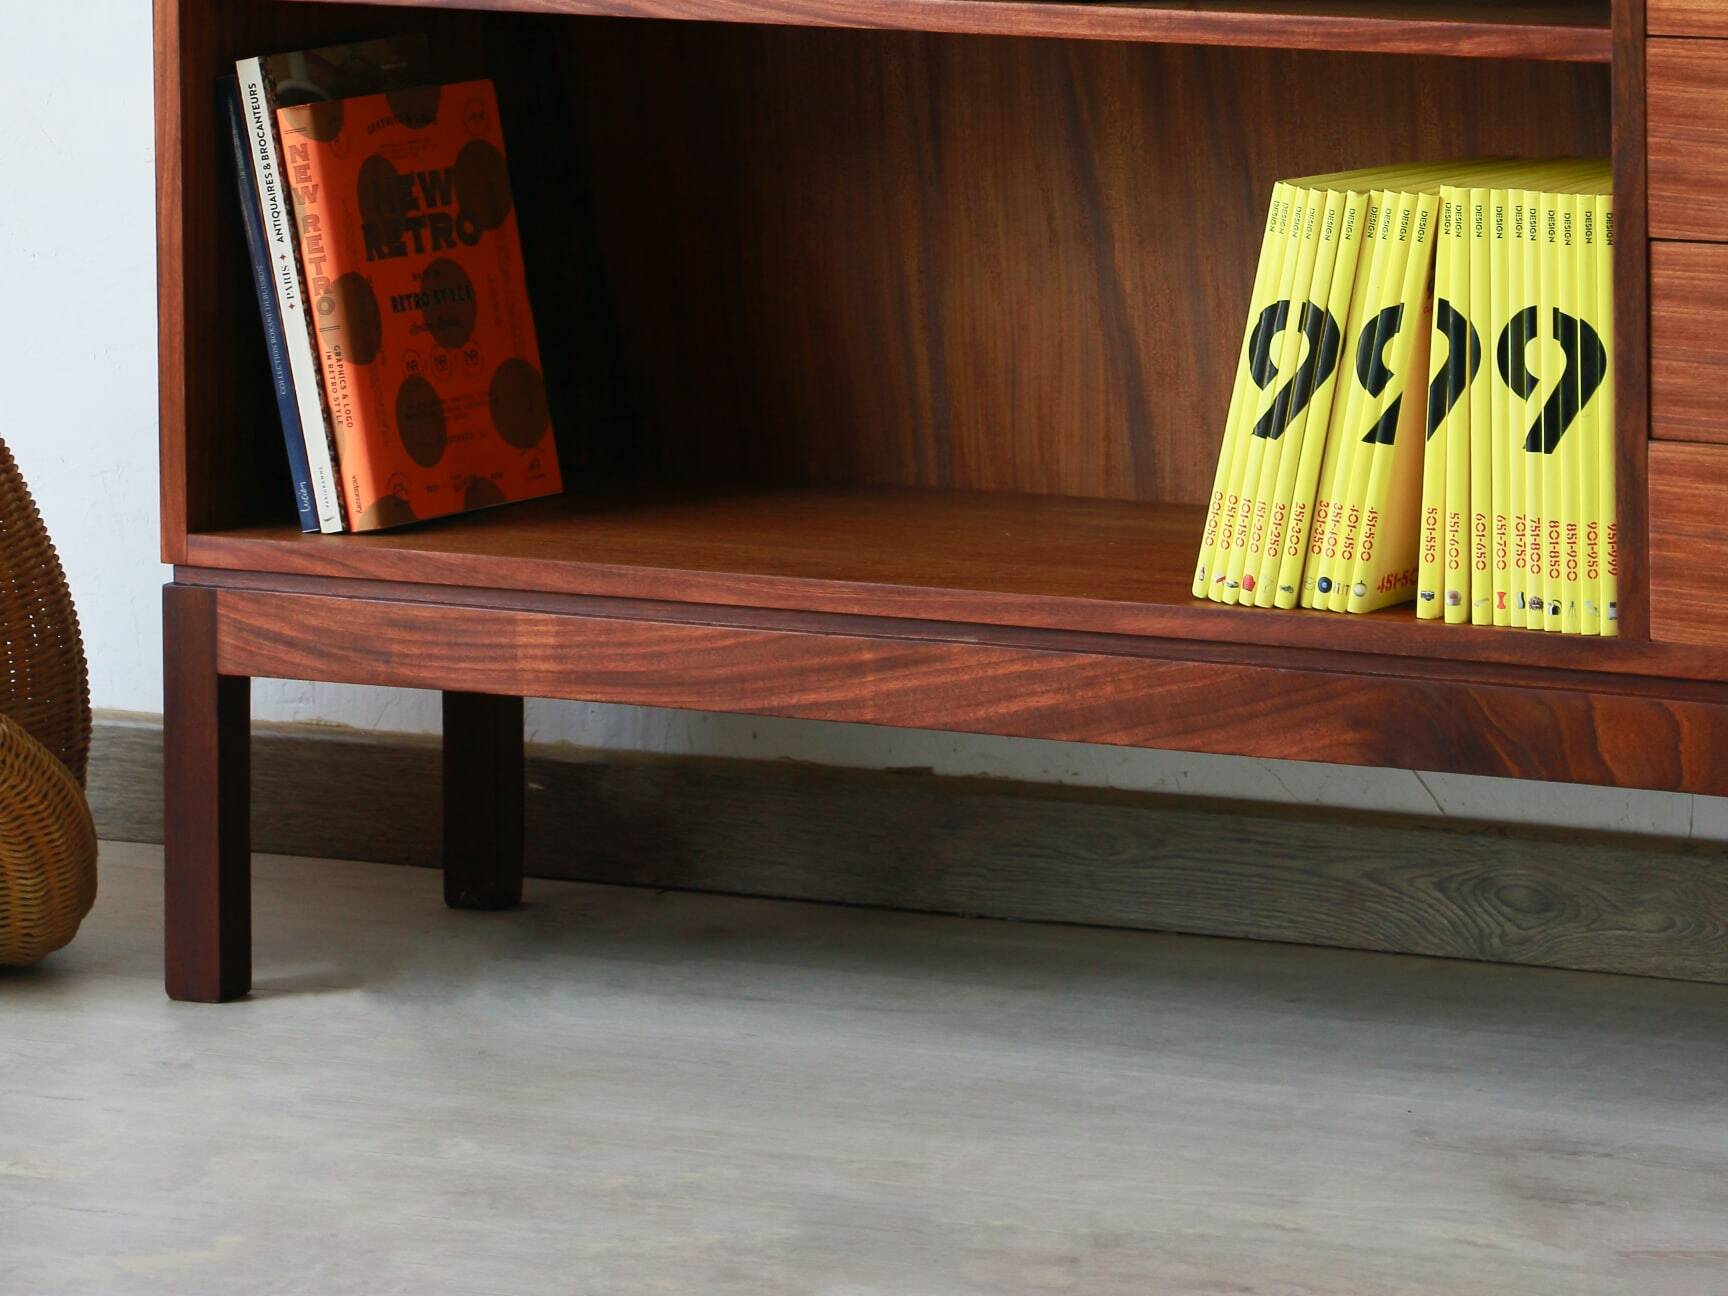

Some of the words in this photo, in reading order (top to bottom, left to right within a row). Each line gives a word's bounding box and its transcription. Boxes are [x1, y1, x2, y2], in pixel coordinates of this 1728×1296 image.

[248, 82, 268, 161] BROCANTEURS
[289, 142, 319, 204] NEW
[263, 172, 284, 243] ANTIQUAIRES
[1270, 201, 1280, 232] DESIGN
[1279, 202, 1289, 235] DESIGN
[1292, 206, 1302, 238] DESIGN
[1305, 208, 1315, 240] DESIGN
[1325, 209, 1336, 241] DESIGN
[1345, 208, 1356, 240] DESIGN
[1368, 206, 1378, 239] DESIGN
[1382, 208, 1392, 240] DESIGN
[1400, 209, 1410, 241] DESIGN
[1417, 211, 1429, 242] DESIGN
[1475, 205, 1483, 238] DESIGN
[1585, 211, 1593, 244] DESIGN
[361, 209, 482, 263] RETRO
[282, 265, 295, 300] PARIS
[302, 214, 336, 316] RETRO
[325, 351, 333, 361] IN
[328, 363, 338, 394] RETRO
[333, 396, 344, 426] STYLE
[334, 344, 347, 391] GRAPHICS
[343, 403, 354, 429] LOGO
[1206, 491, 1223, 546] 001-050
[1221, 494, 1238, 550] 051-100
[1236, 497, 1252, 547] 101-150
[1250, 500, 1266, 553] 151-200
[1268, 503, 1285, 557] 201-250
[1288, 502, 1306, 556] 251-300
[1312, 500, 1330, 555] 301-350
[1424, 507, 1438, 563] 501-550
[1449, 512, 1460, 570] 551-600
[1475, 513, 1486, 570] 601-650
[1496, 515, 1506, 570] 651-700
[1516, 514, 1526, 568] 701-750
[1530, 517, 1541, 574] 751-800
[1549, 520, 1560, 579] 801-850
[1566, 524, 1577, 581] 851-900
[1587, 522, 1598, 579] 901-950
